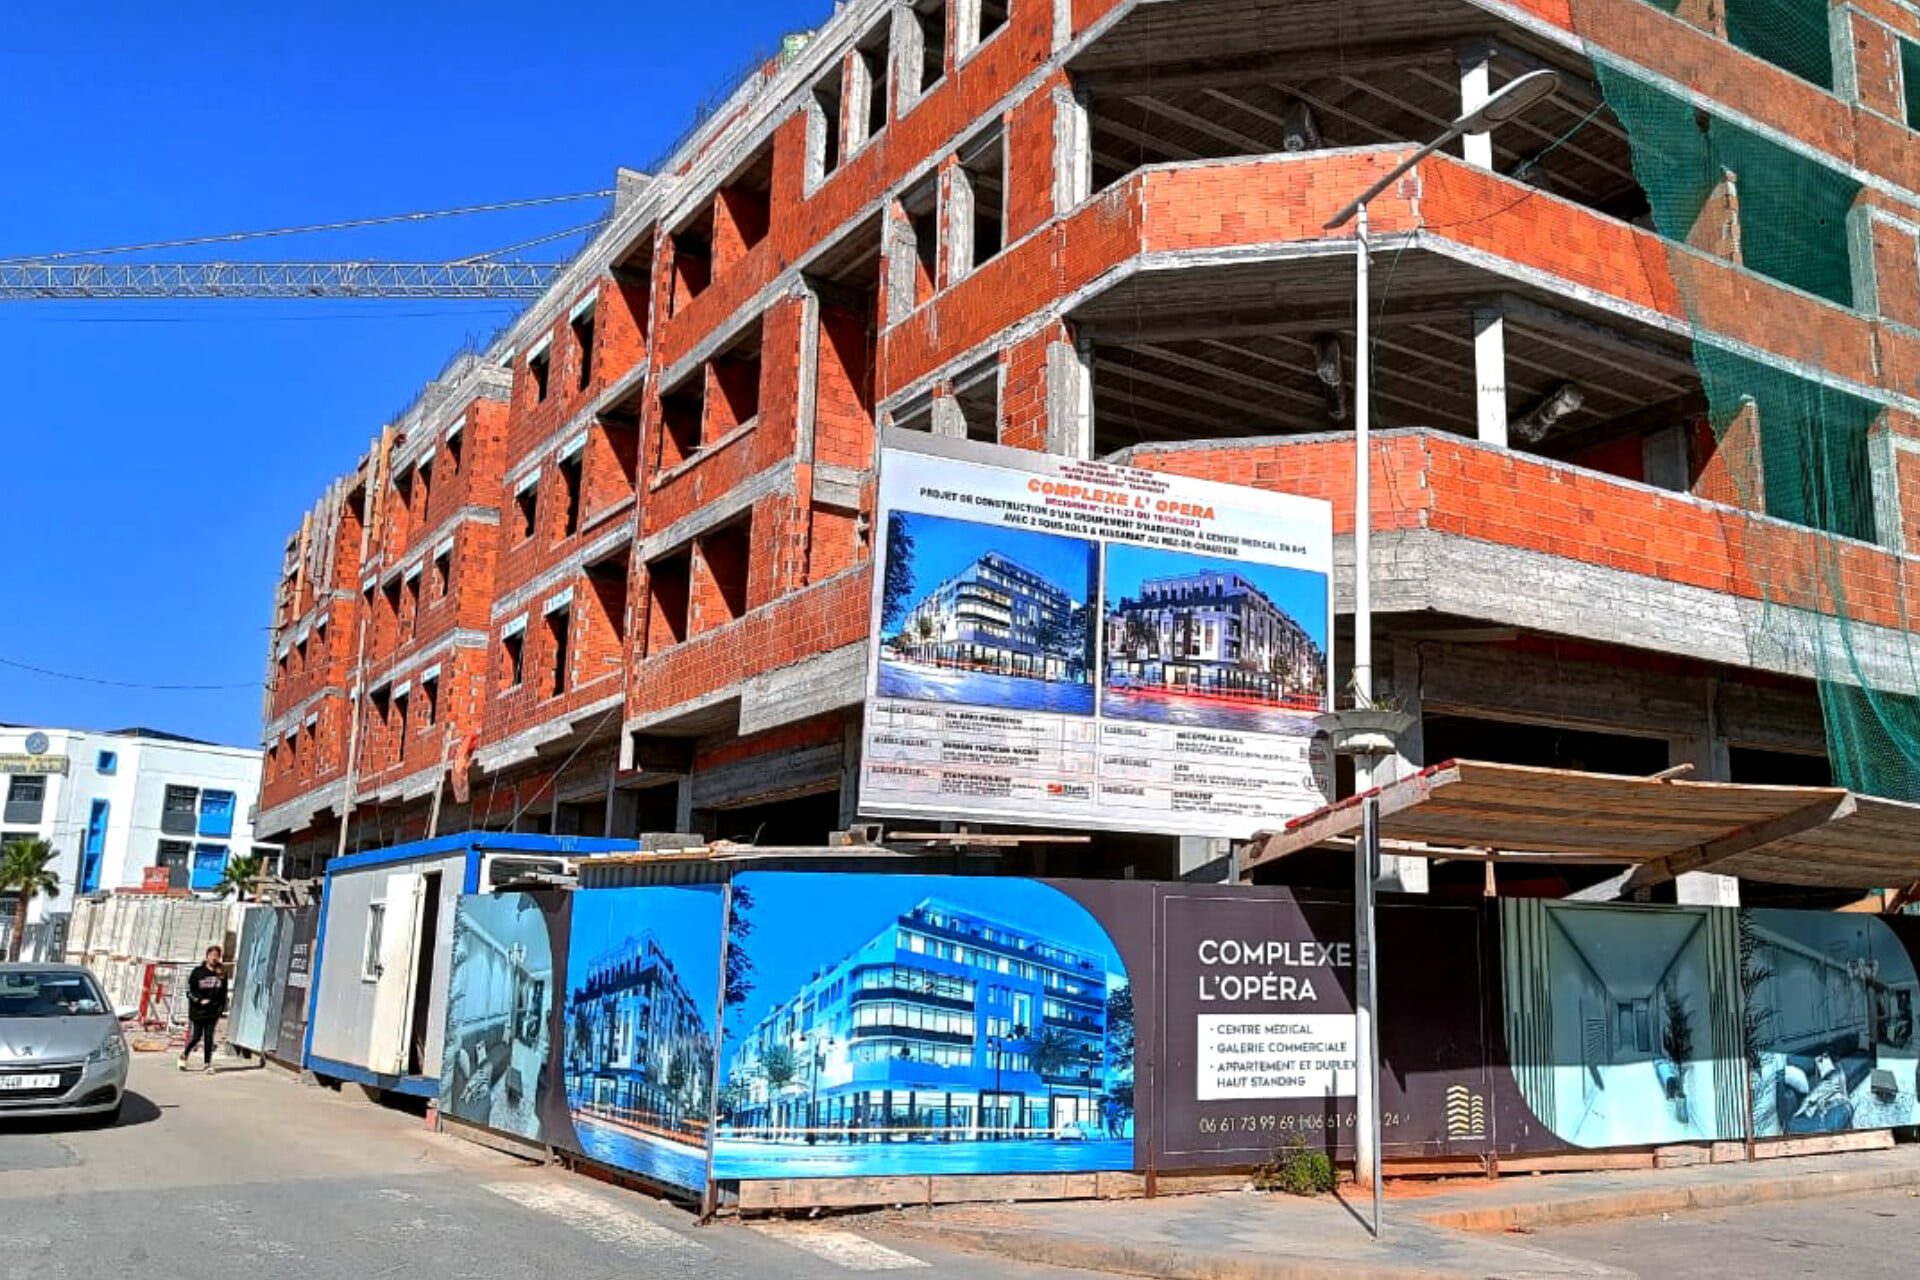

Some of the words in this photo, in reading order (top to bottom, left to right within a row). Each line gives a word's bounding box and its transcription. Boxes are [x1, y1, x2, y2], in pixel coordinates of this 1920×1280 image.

[919, 486, 958, 502] PROJET
[959, 494, 974, 505] DE
[975, 496, 1049, 516] CONSTRUCTION
[1027, 478, 1129, 506] COMPLEXE
[1134, 496, 1151, 510] L'
[1156, 499, 1216, 521] OPERA
[1003, 512, 1029, 525] AVEC
[1198, 940, 1352, 967] COMPLEXE
[1199, 971, 1317, 1001] L'OPÉRA
[1216, 1024, 1261, 1035] CENTRE
[1216, 1042, 1265, 1053] GALERIE
[1268, 1041, 1348, 1053] COMMERCIALE
[1216, 1060, 1295, 1073] APPARTEMENT
[1299, 1060, 1312, 1071] ET
[1216, 1077, 1247, 1088] HAUT
[1250, 1076, 1307, 1088] STANDING
[1199, 1118, 1217, 1133] 06
[1220, 1117, 1235, 1132] 61
[1240, 1116, 1256, 1131] 73
[1260, 1115, 1276, 1130] 99
